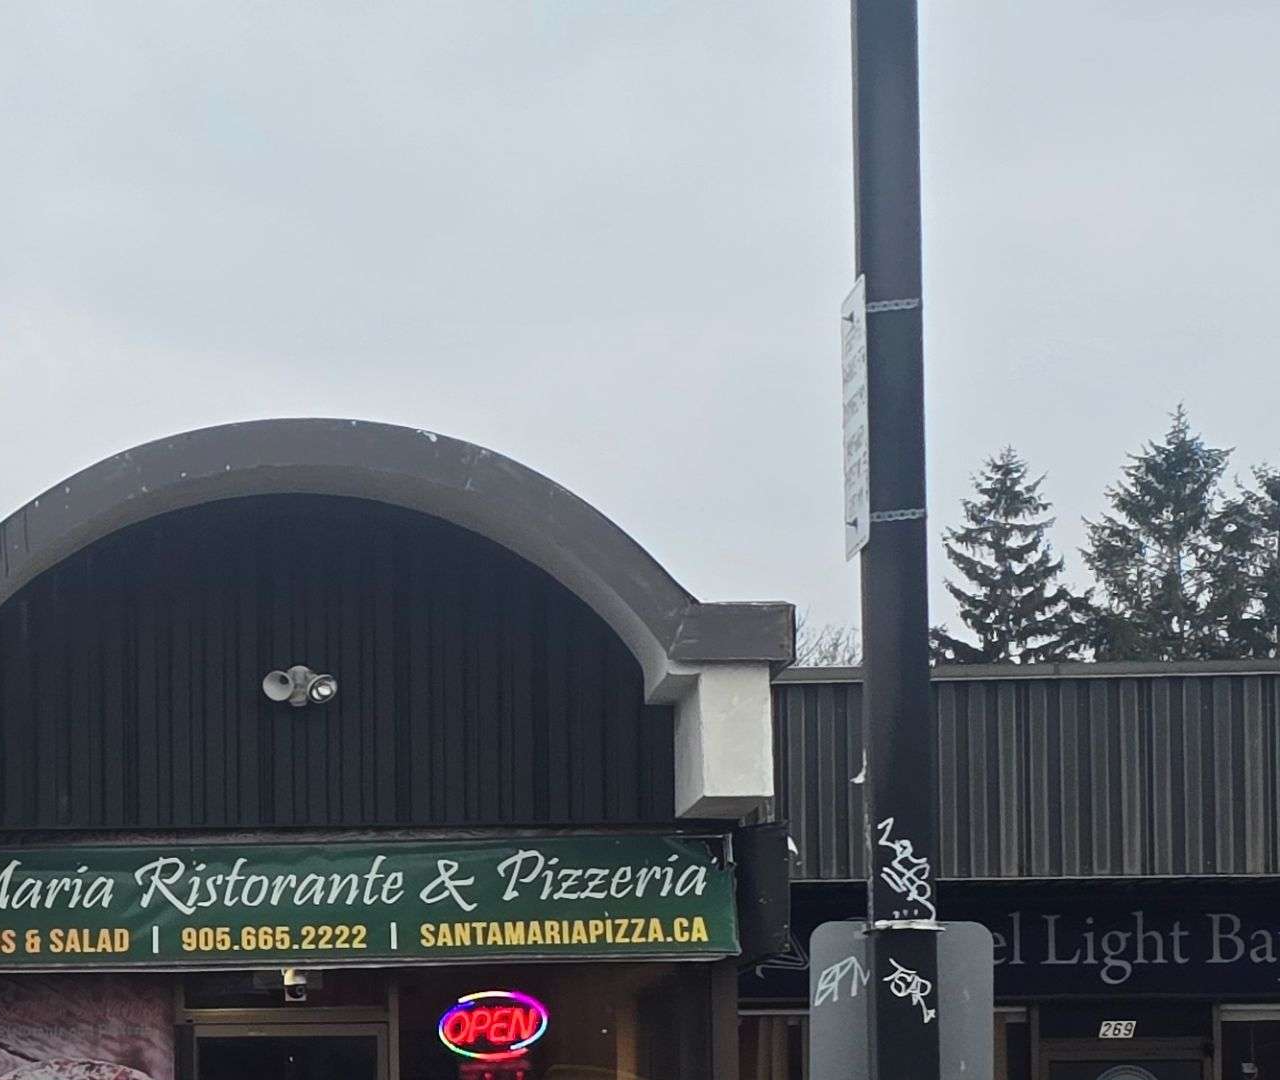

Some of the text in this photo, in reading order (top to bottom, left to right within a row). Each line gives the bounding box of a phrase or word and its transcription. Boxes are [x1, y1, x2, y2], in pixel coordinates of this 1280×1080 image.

[134, 855, 404, 915] Ristorante
[419, 859, 478, 911] &
[496, 849, 708, 902] Pizzeria
[24, 928, 42, 954] &
[48, 927, 130, 954] SALAD
[181, 924, 368, 952] 905.665.2222
[420, 916, 710, 946] SANTAMARIAPIZZA.CA
[1040, 911, 1191, 985] Light
[443, 1006, 539, 1044] OPEN
[1100, 1021, 1135, 1039] 269
